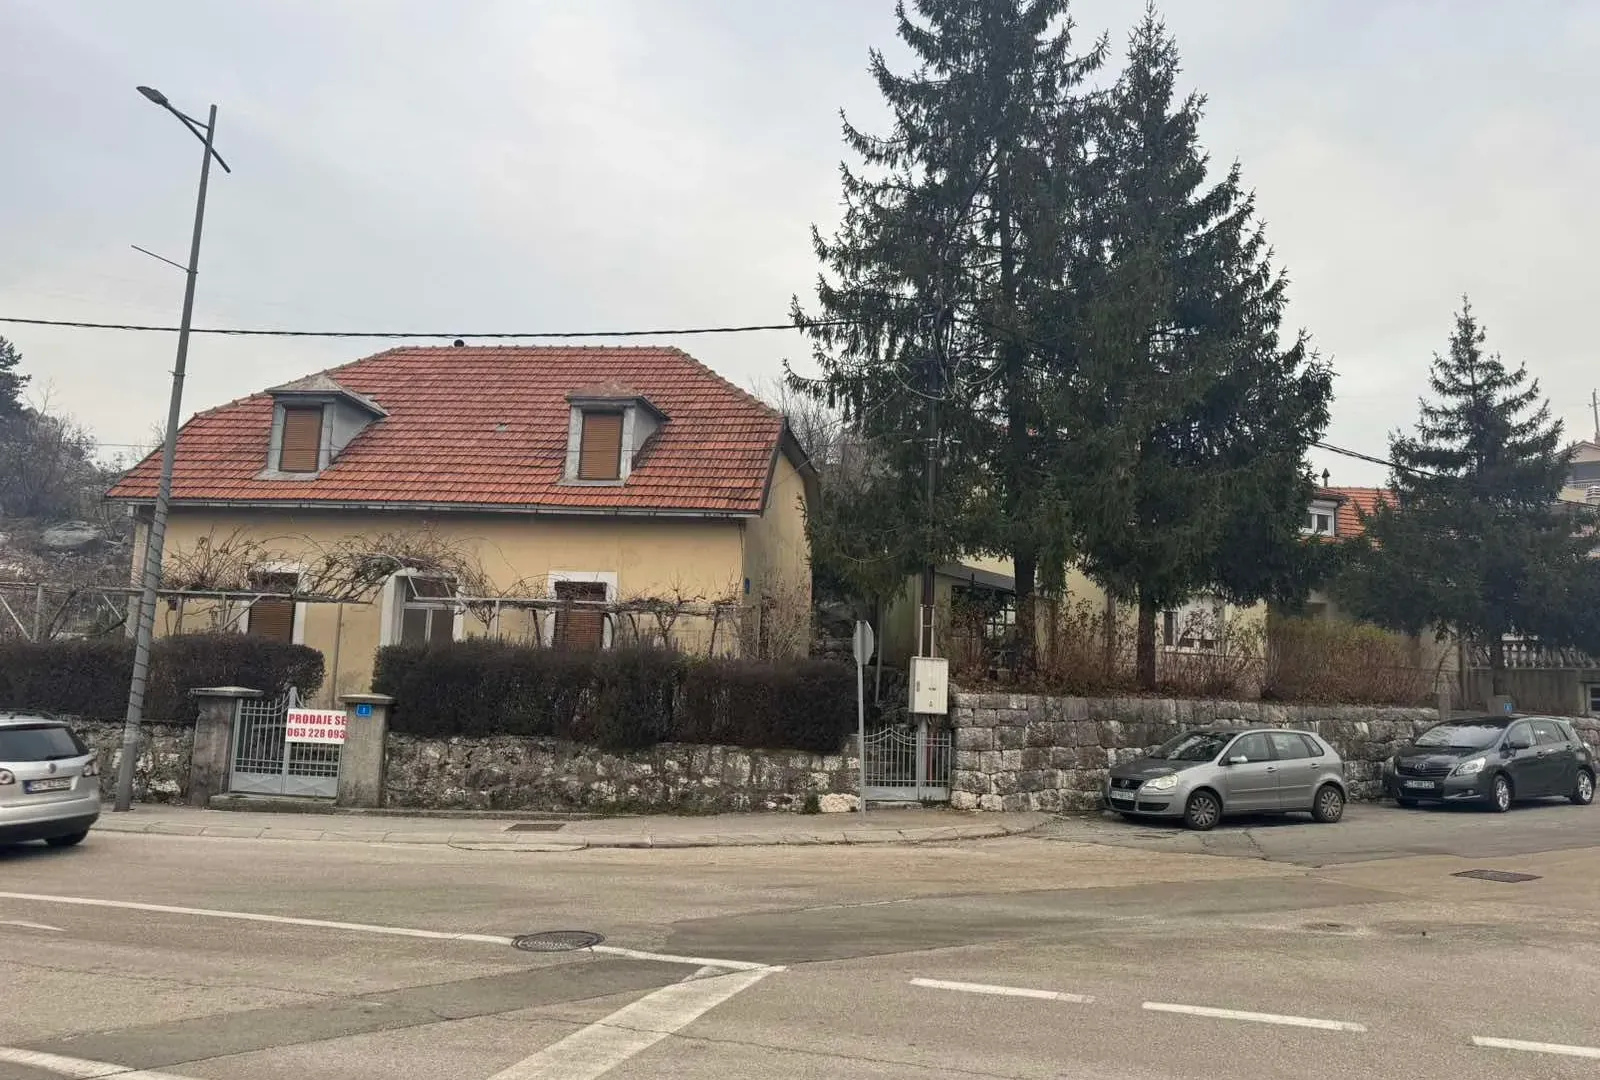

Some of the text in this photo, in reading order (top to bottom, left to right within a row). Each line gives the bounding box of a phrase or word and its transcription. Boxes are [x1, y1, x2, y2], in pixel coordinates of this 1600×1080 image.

[288, 713, 348, 726] PRODAJE SE
[287, 727, 346, 739] 063 228 093
